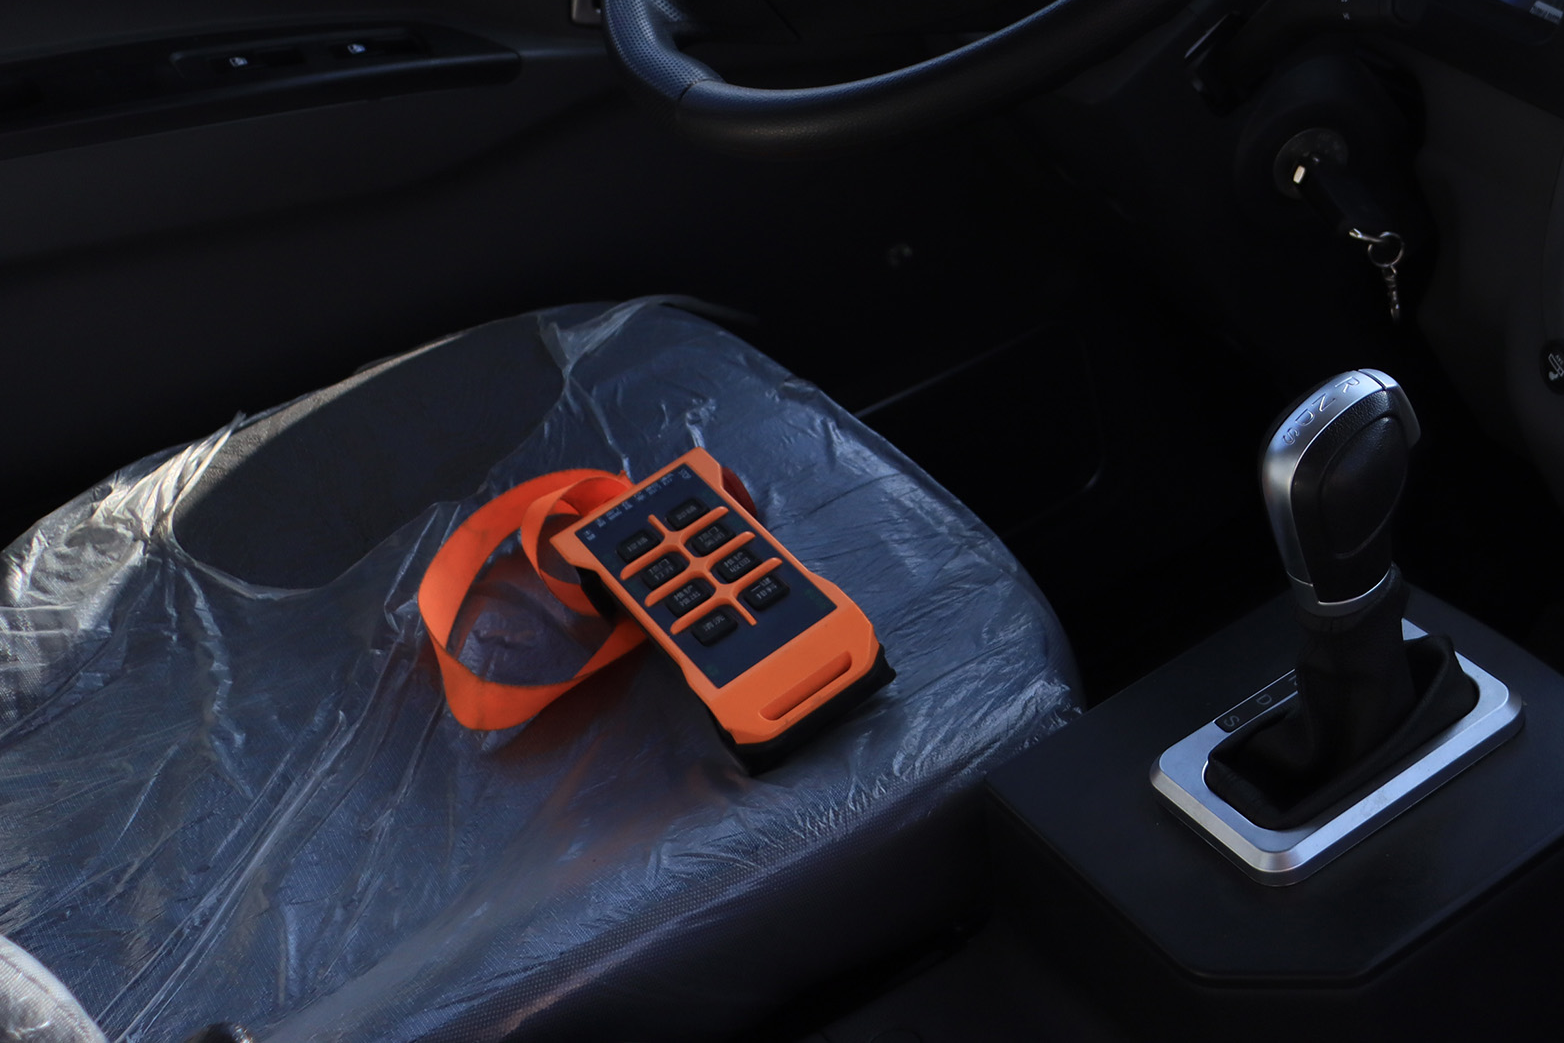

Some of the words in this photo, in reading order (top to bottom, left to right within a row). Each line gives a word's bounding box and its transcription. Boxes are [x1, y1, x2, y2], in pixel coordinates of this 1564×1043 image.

[1335, 375, 1359, 394] R
[1311, 393, 1336, 413] N
[1295, 408, 1315, 428] D
[1282, 426, 1299, 446] S
[1255, 692, 1273, 706] D
[1223, 714, 1240, 729] S
